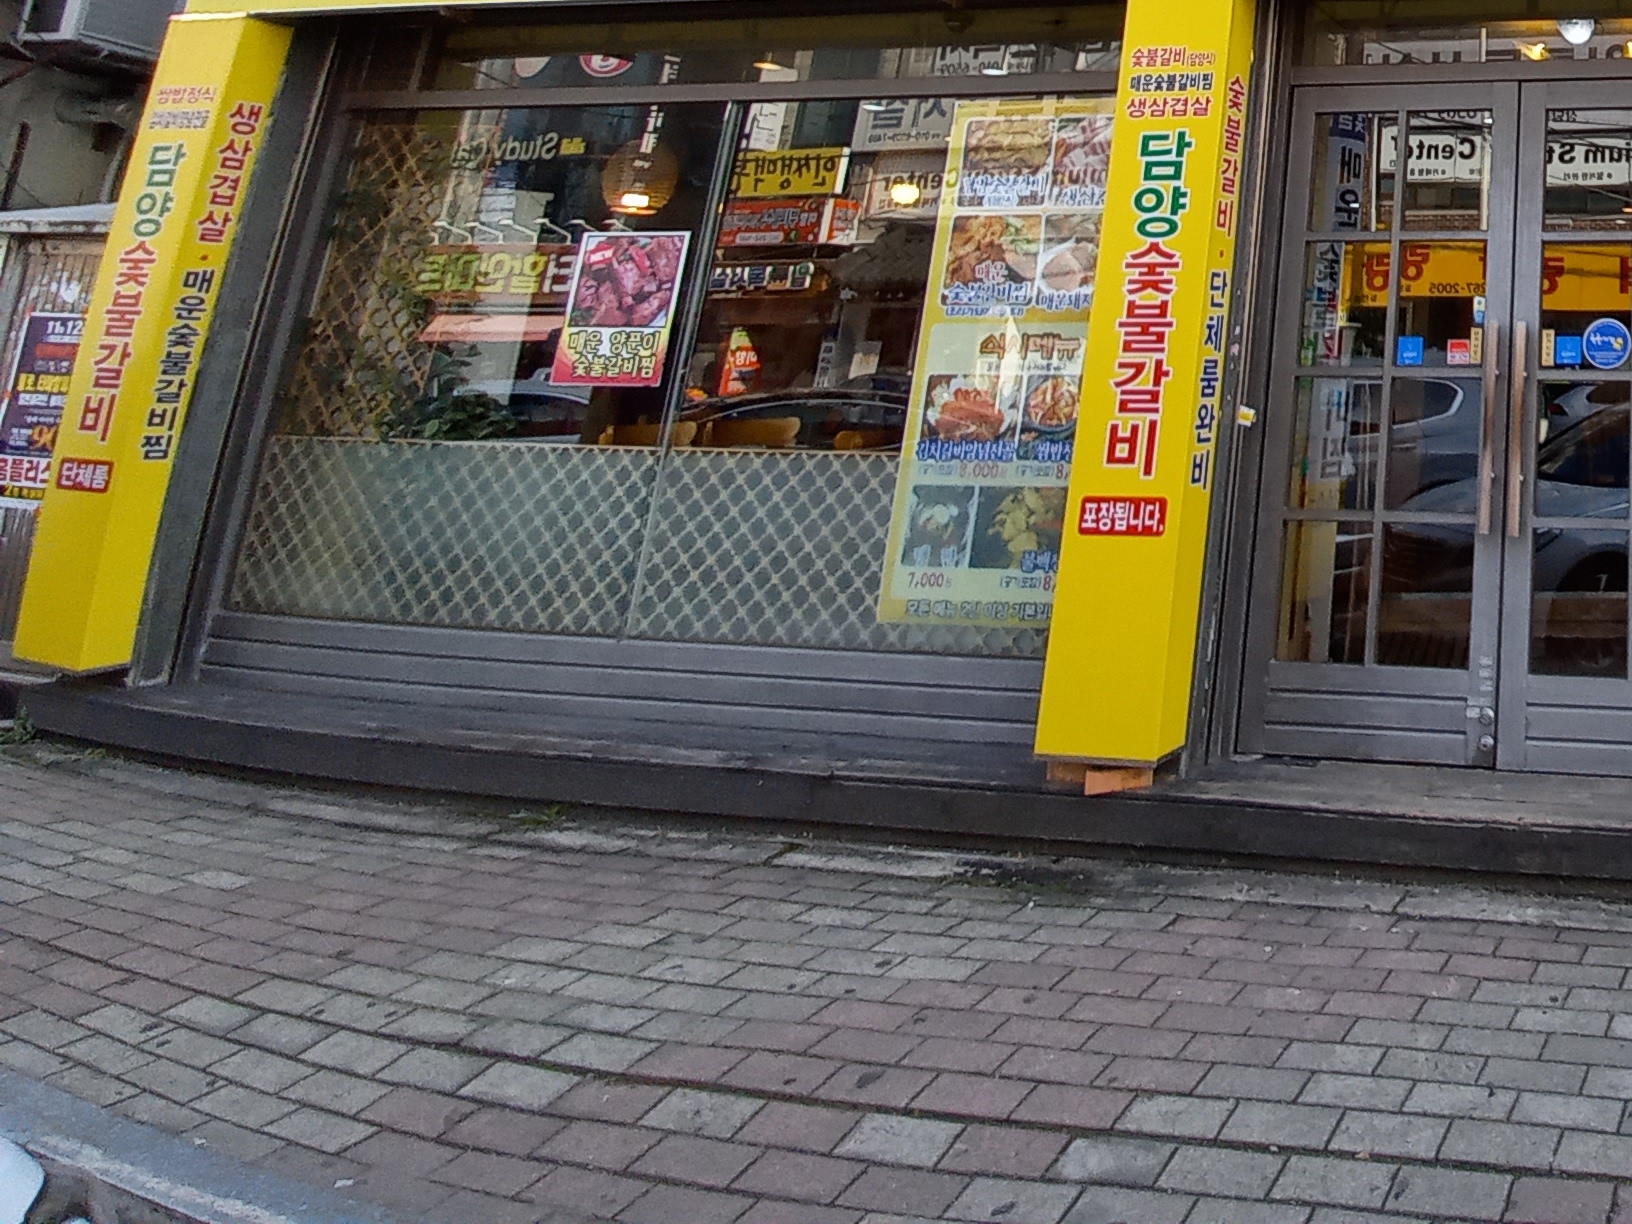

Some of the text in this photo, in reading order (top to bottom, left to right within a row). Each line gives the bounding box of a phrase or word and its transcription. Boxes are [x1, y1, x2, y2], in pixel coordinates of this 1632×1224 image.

[1126, 95, 1213, 119] 생삼겹살
[568, 330, 603, 353] 매운
[571, 354, 658, 379] 숯불갈비찜
